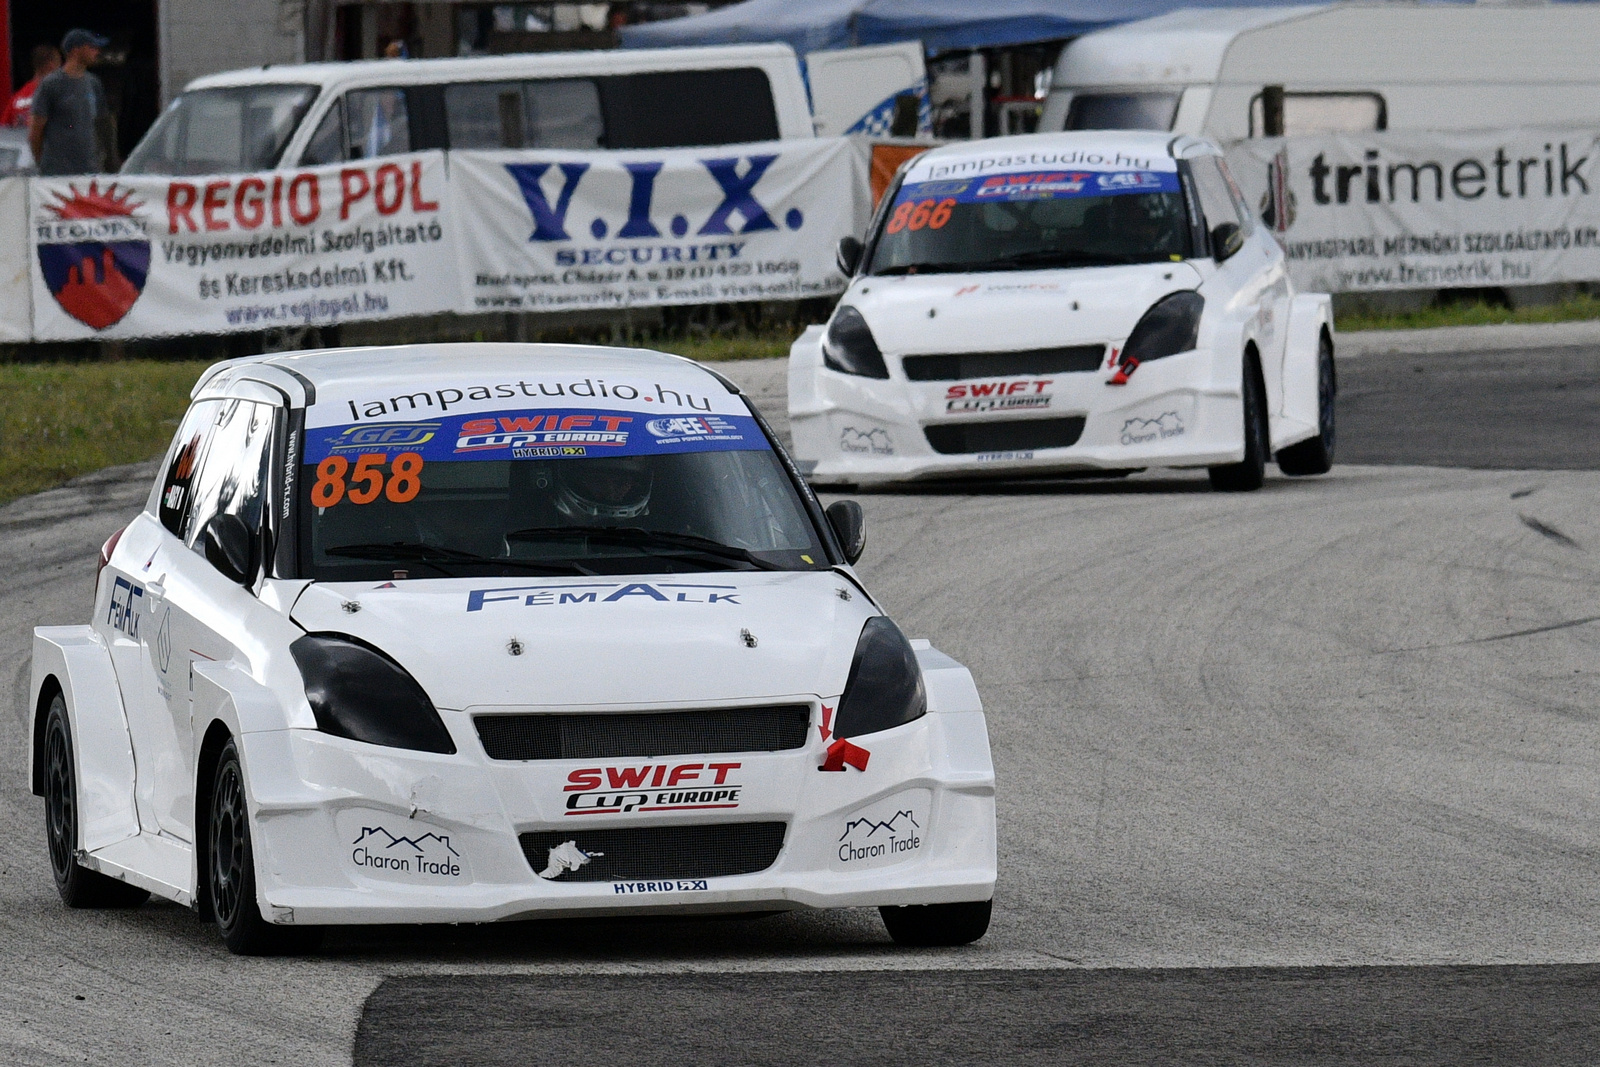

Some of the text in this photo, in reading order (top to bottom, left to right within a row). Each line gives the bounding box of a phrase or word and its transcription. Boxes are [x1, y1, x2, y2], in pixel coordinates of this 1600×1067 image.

[928, 152, 1150, 180] lampastudio.hu
[1309, 143, 1590, 205] trimetrik
[167, 161, 440, 234] REGIO POL
[504, 153, 804, 242] V.I.X.
[887, 198, 957, 235] 866
[321, 218, 443, 254] Szolgáltató
[555, 242, 746, 266] SECURITY
[225, 262, 368, 297] Kereskedelmi
[373, 257, 414, 283] Kft.
[347, 379, 713, 421] lampastudio.hu
[945, 379, 1054, 399] SWIFT
[458, 415, 634, 437] SWIFT
[542, 432, 629, 444] EUROPE
[328, 444, 425, 456] Racing Team
[512, 446, 559, 458] HYBRID
[281, 430, 297, 519] www.hybrid-rx.com
[310, 451, 424, 508] 858
[562, 762, 742, 792] SWIFT
[655, 789, 742, 805] EUROPE
[839, 829, 920, 862] Charon Trade
[352, 846, 461, 877] Charon Trade
[613, 881, 674, 894] HYBRID
